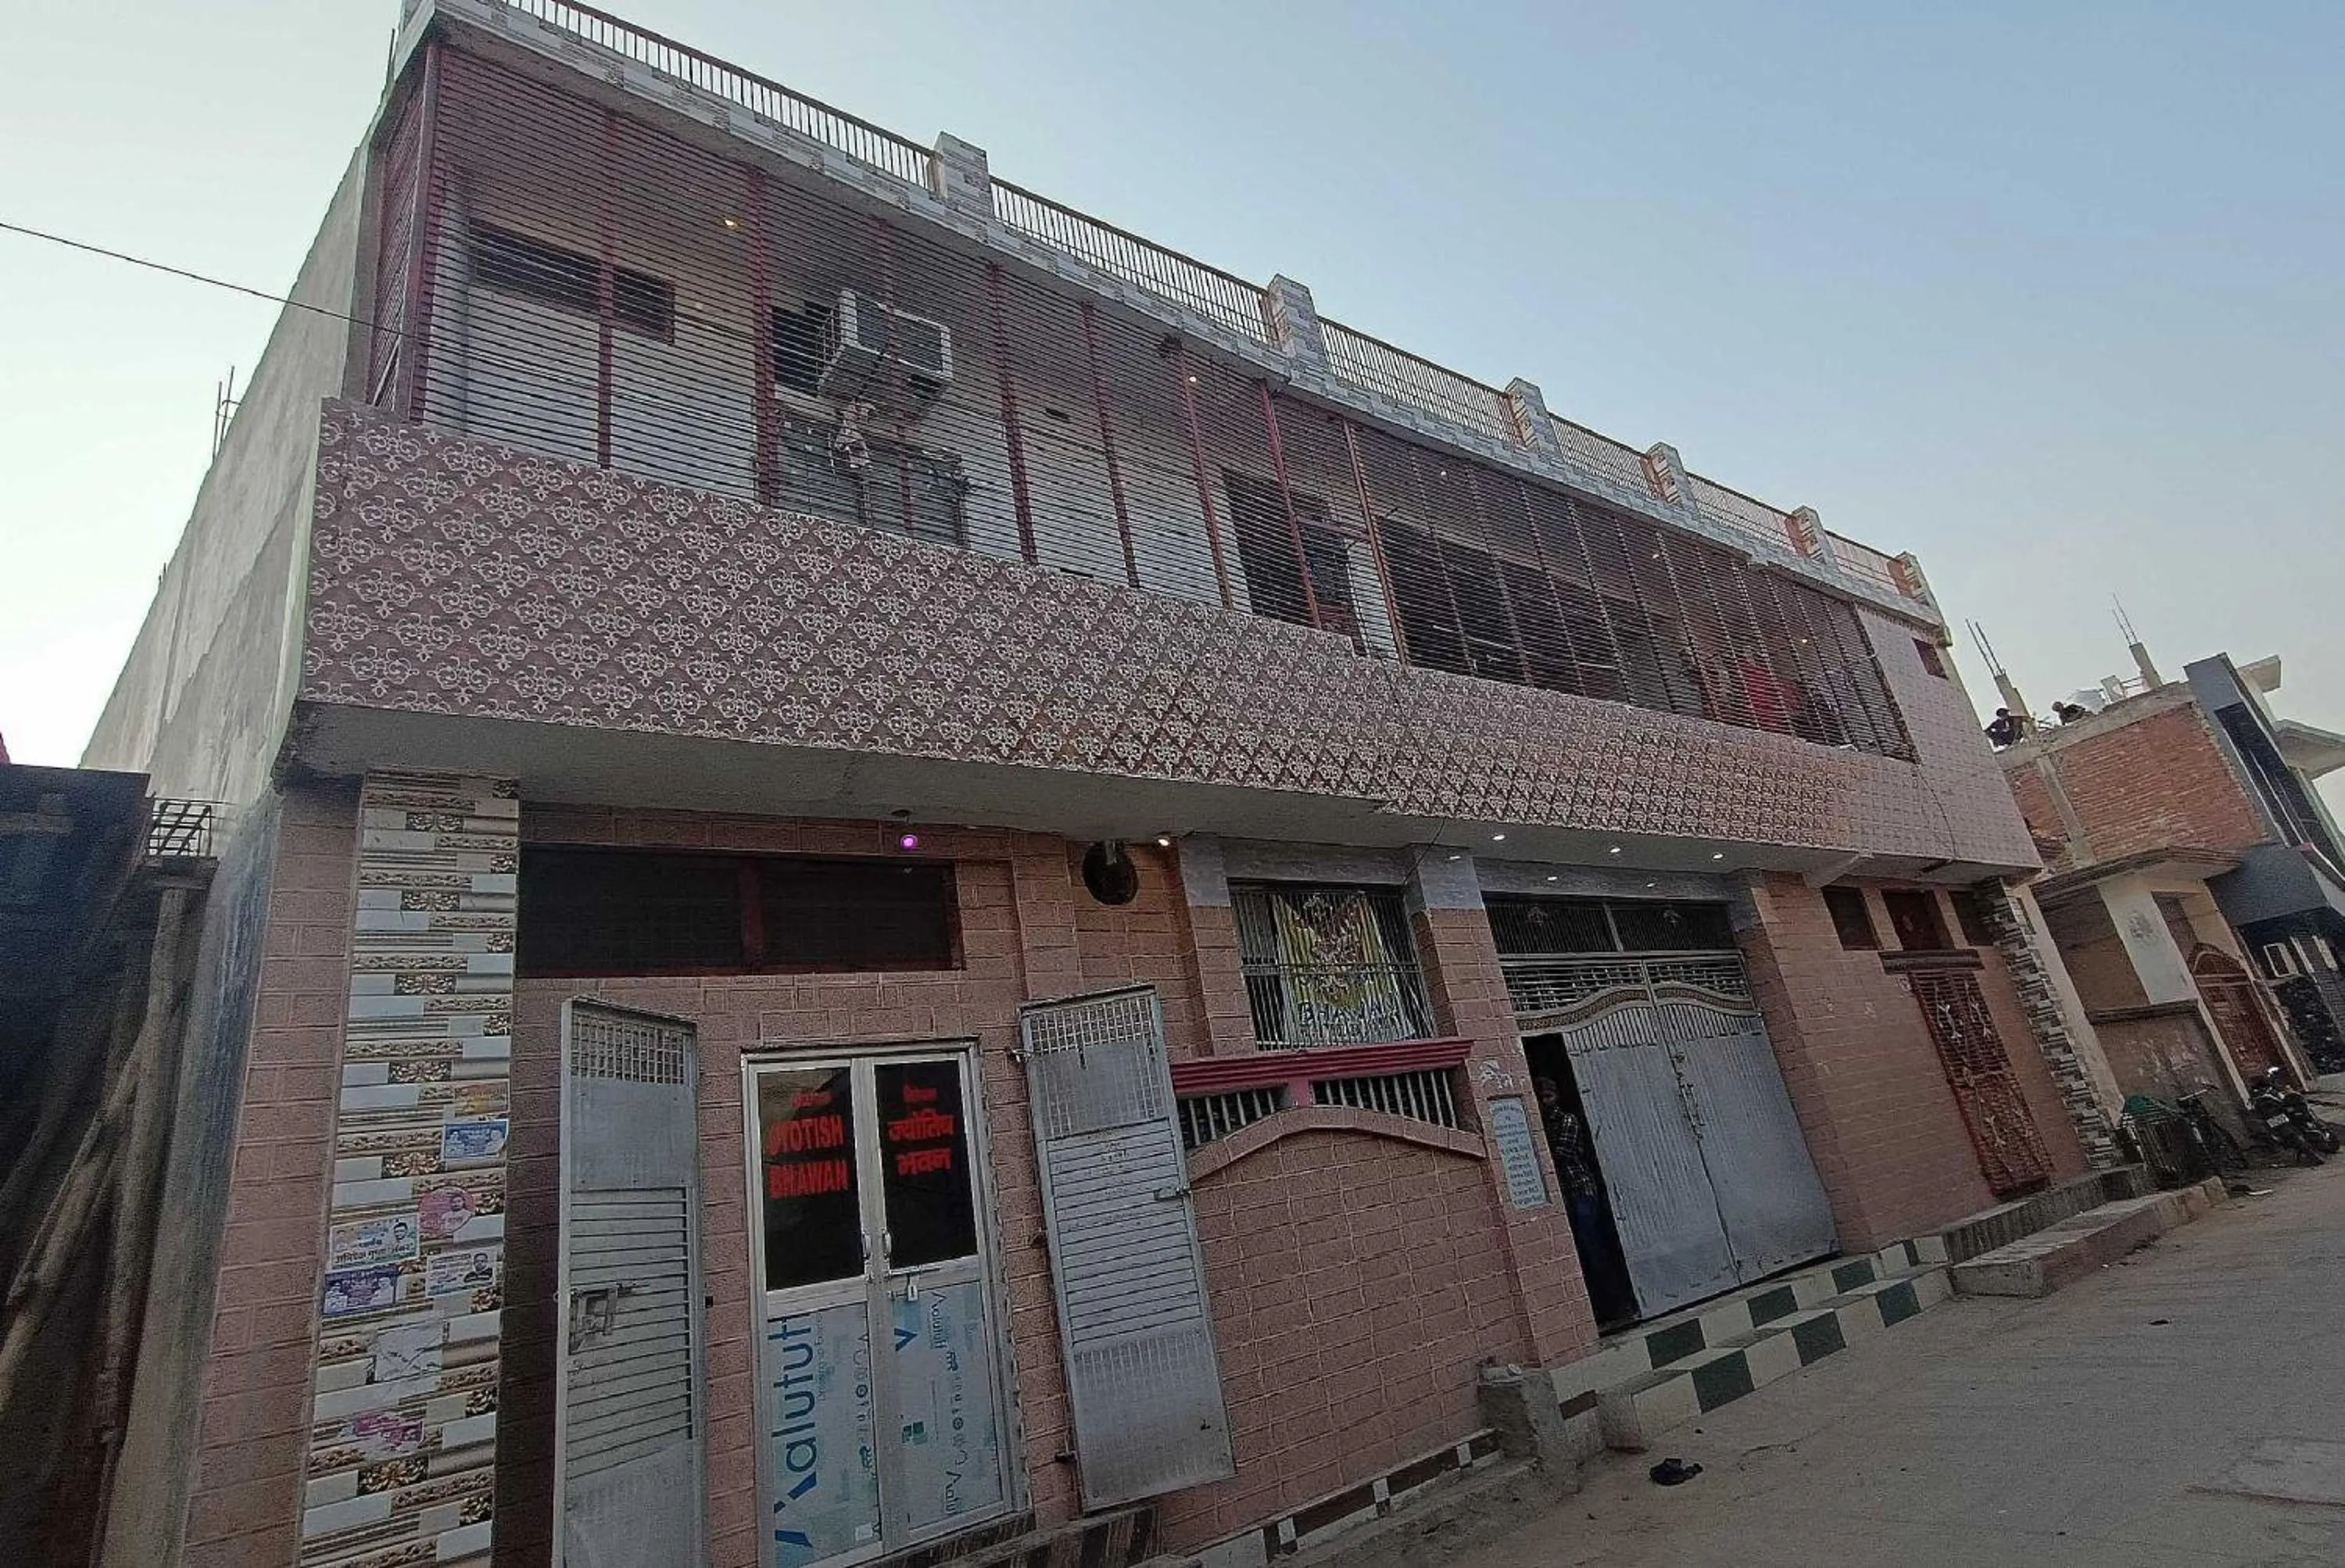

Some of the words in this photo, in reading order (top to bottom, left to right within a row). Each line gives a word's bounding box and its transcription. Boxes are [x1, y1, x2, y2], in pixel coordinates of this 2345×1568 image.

[768, 1115, 844, 1156] JYOTISH
[768, 1160, 849, 1199] BHAWAN
[895, 1147, 951, 1176] भवन
